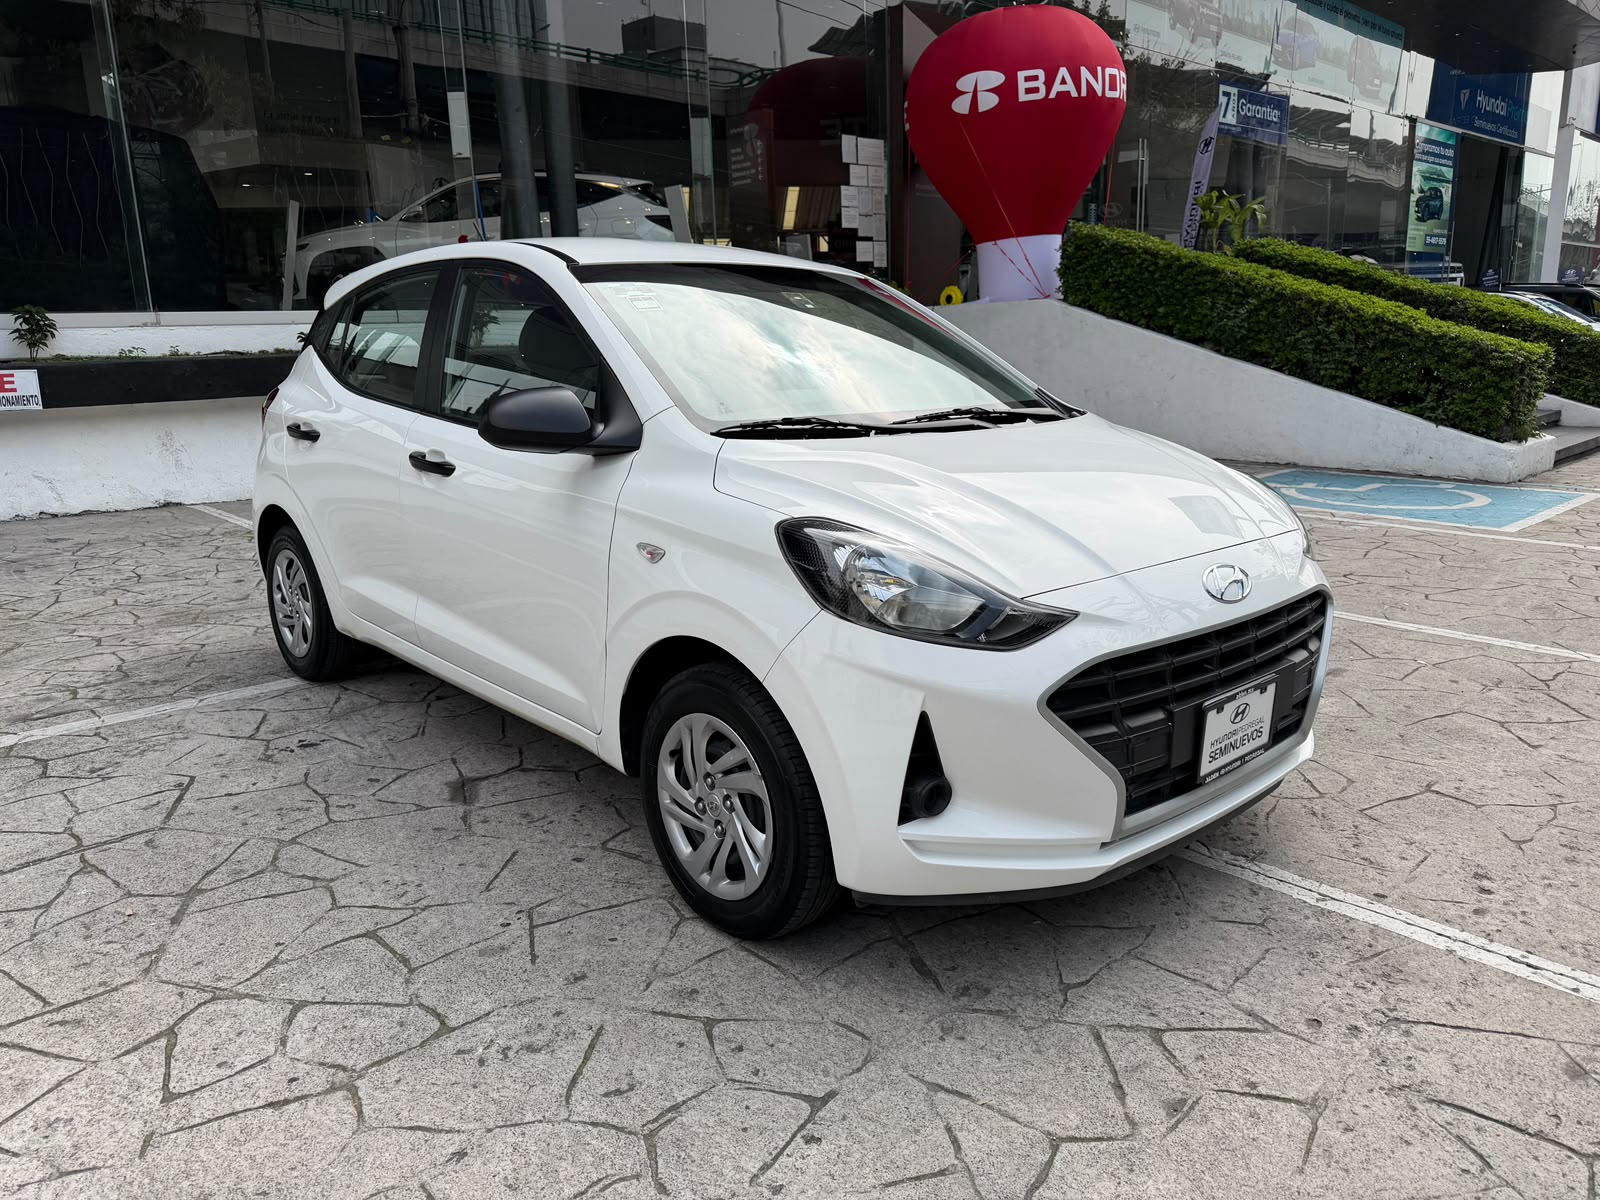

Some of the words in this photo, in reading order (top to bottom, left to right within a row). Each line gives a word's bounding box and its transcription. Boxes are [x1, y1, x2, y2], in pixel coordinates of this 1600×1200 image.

[1221, 90, 1232, 119] 7
[1475, 89, 1508, 116] Hyundai
[1474, 116, 1496, 131] Seminuevos
[1496, 123, 1518, 139] Certificados
[1415, 139, 1441, 154] Compramos
[1444, 149, 1454, 157] auto
[0, 373, 17, 393] E
[1208, 726, 1264, 764] SEMINUEVOS
